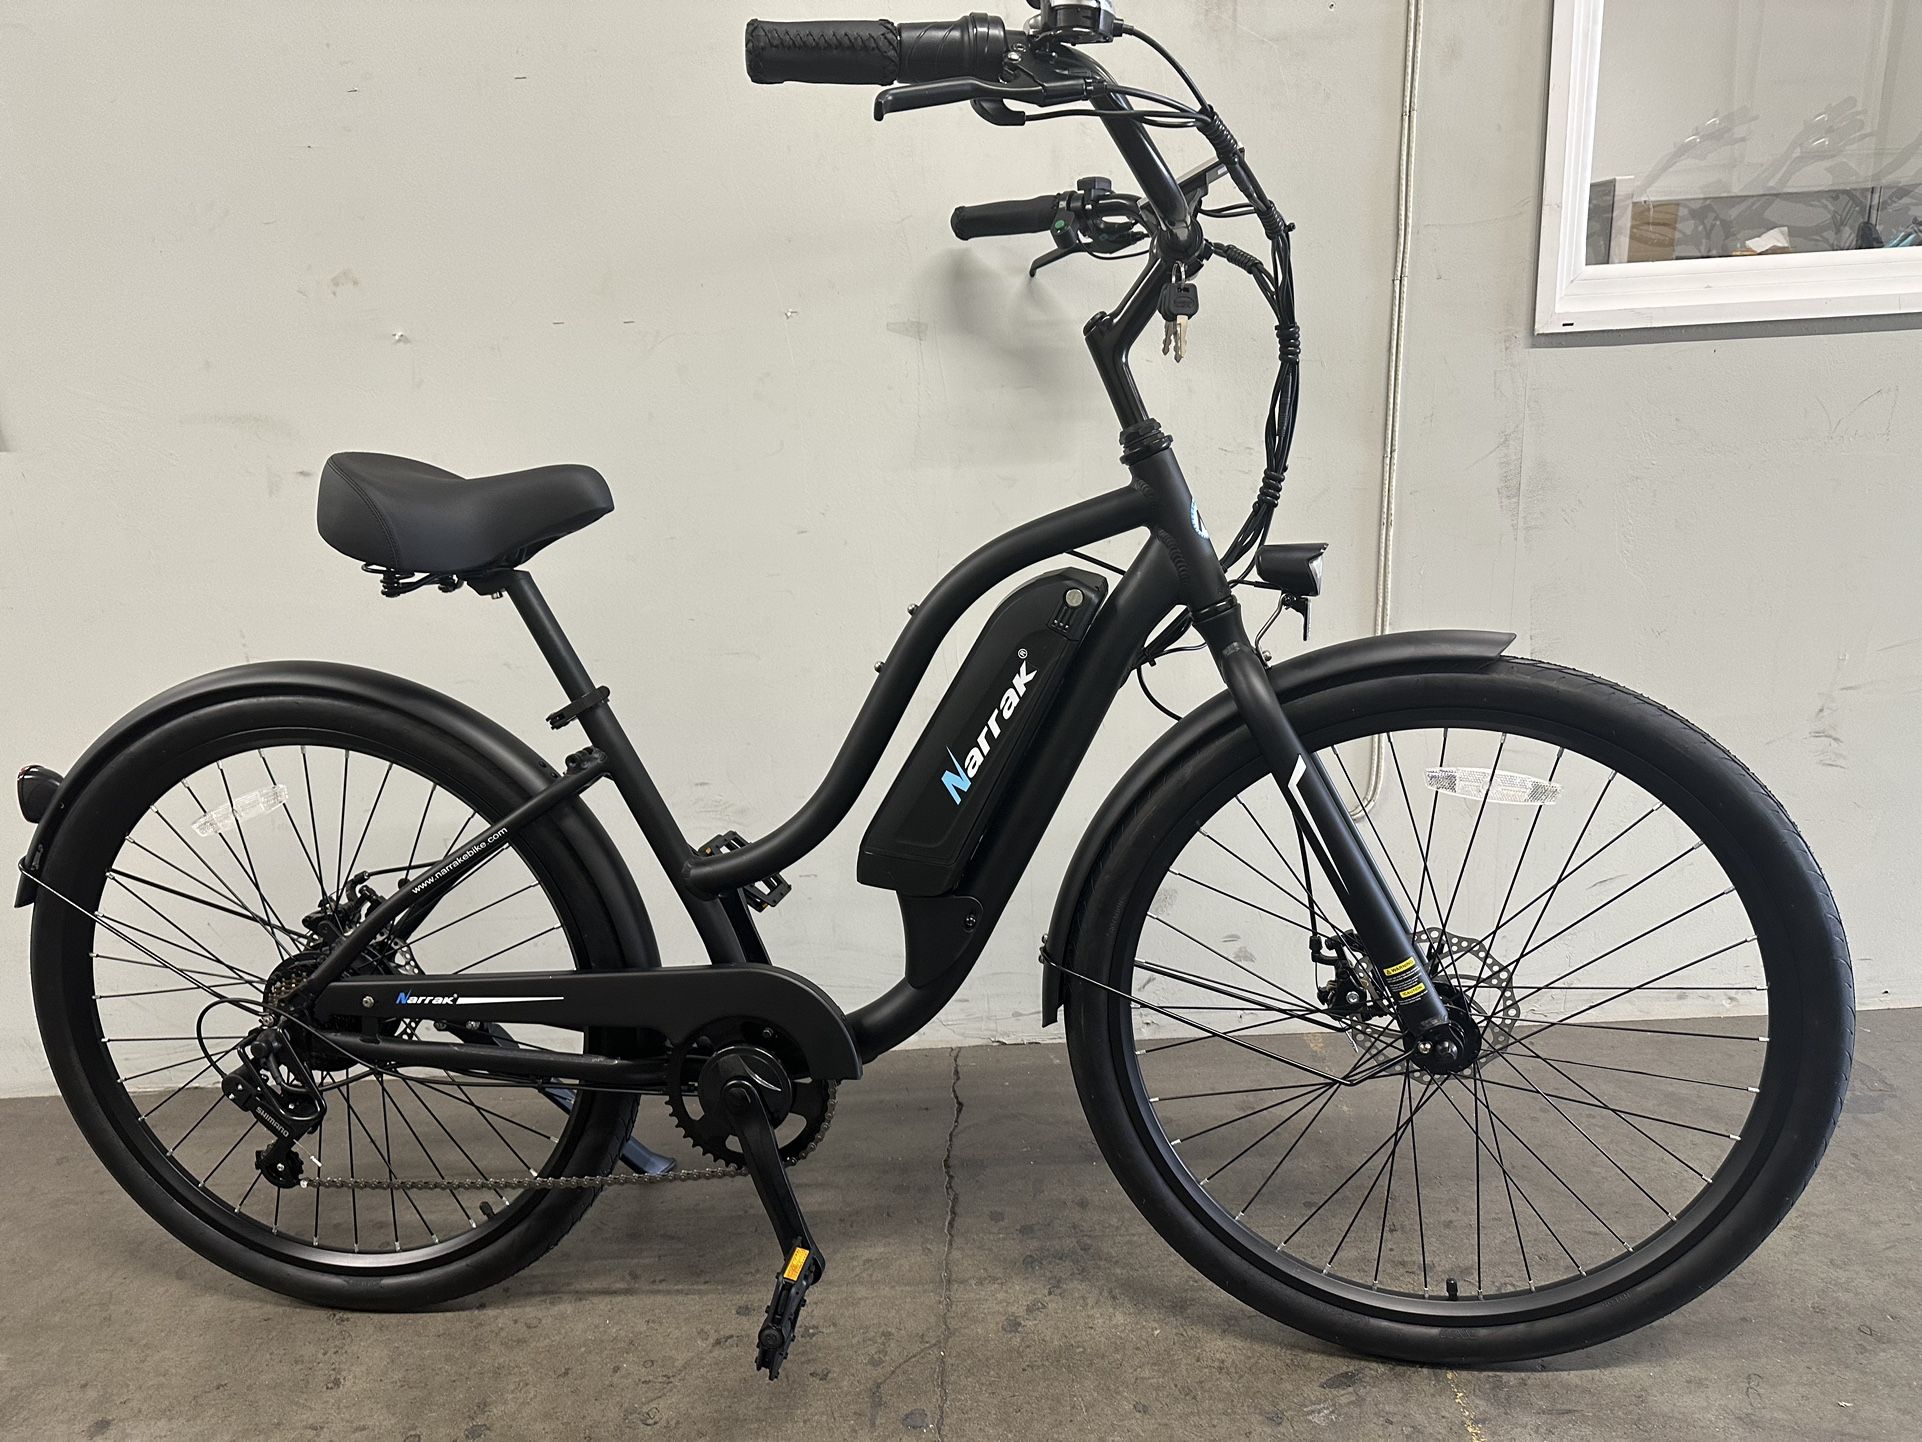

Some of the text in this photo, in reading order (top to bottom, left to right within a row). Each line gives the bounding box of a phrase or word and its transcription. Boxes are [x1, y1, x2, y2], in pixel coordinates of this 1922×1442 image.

[411, 827, 508, 894] www.narrakebike.com
[1391, 959, 1414, 973] WARNING
[256, 1106, 289, 1138] SHIMANO
